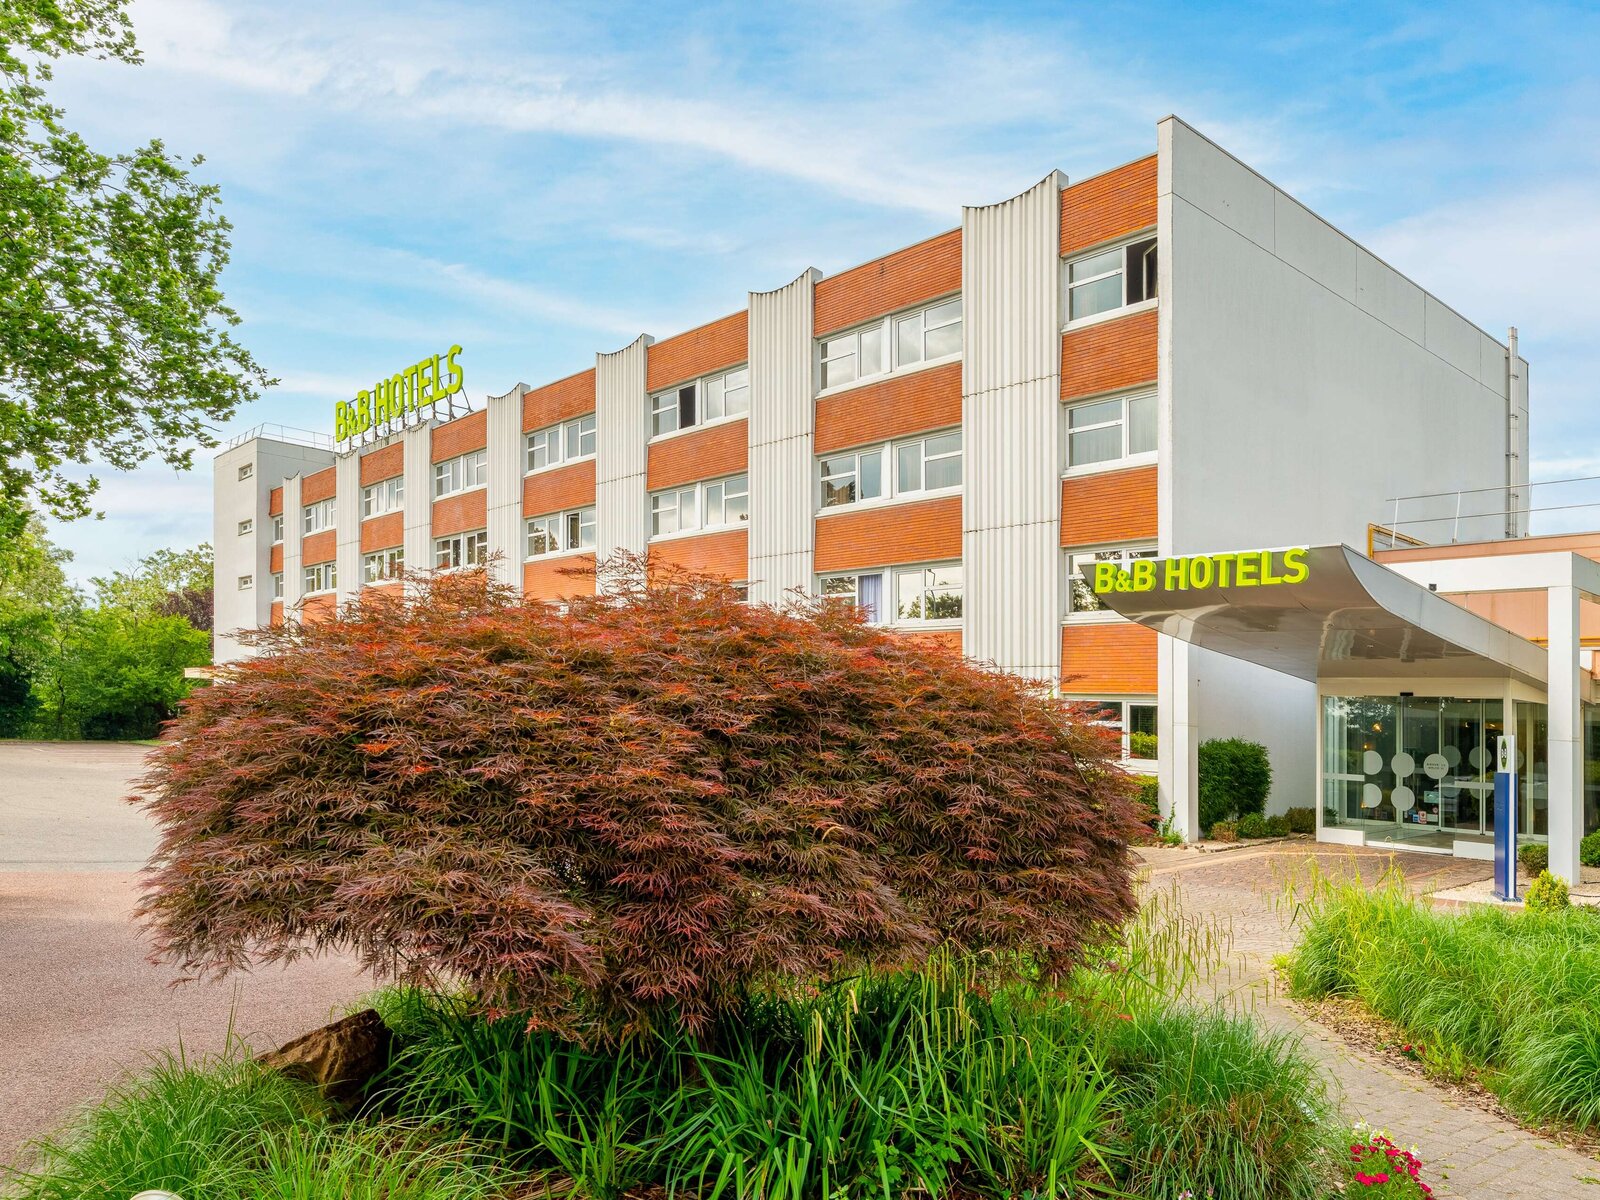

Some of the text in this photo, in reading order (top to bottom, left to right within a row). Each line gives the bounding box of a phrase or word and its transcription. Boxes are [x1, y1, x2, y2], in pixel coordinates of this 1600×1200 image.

[335, 344, 463, 443] B&B HOTELS
[1095, 548, 1310, 594] B&B HOTELS
